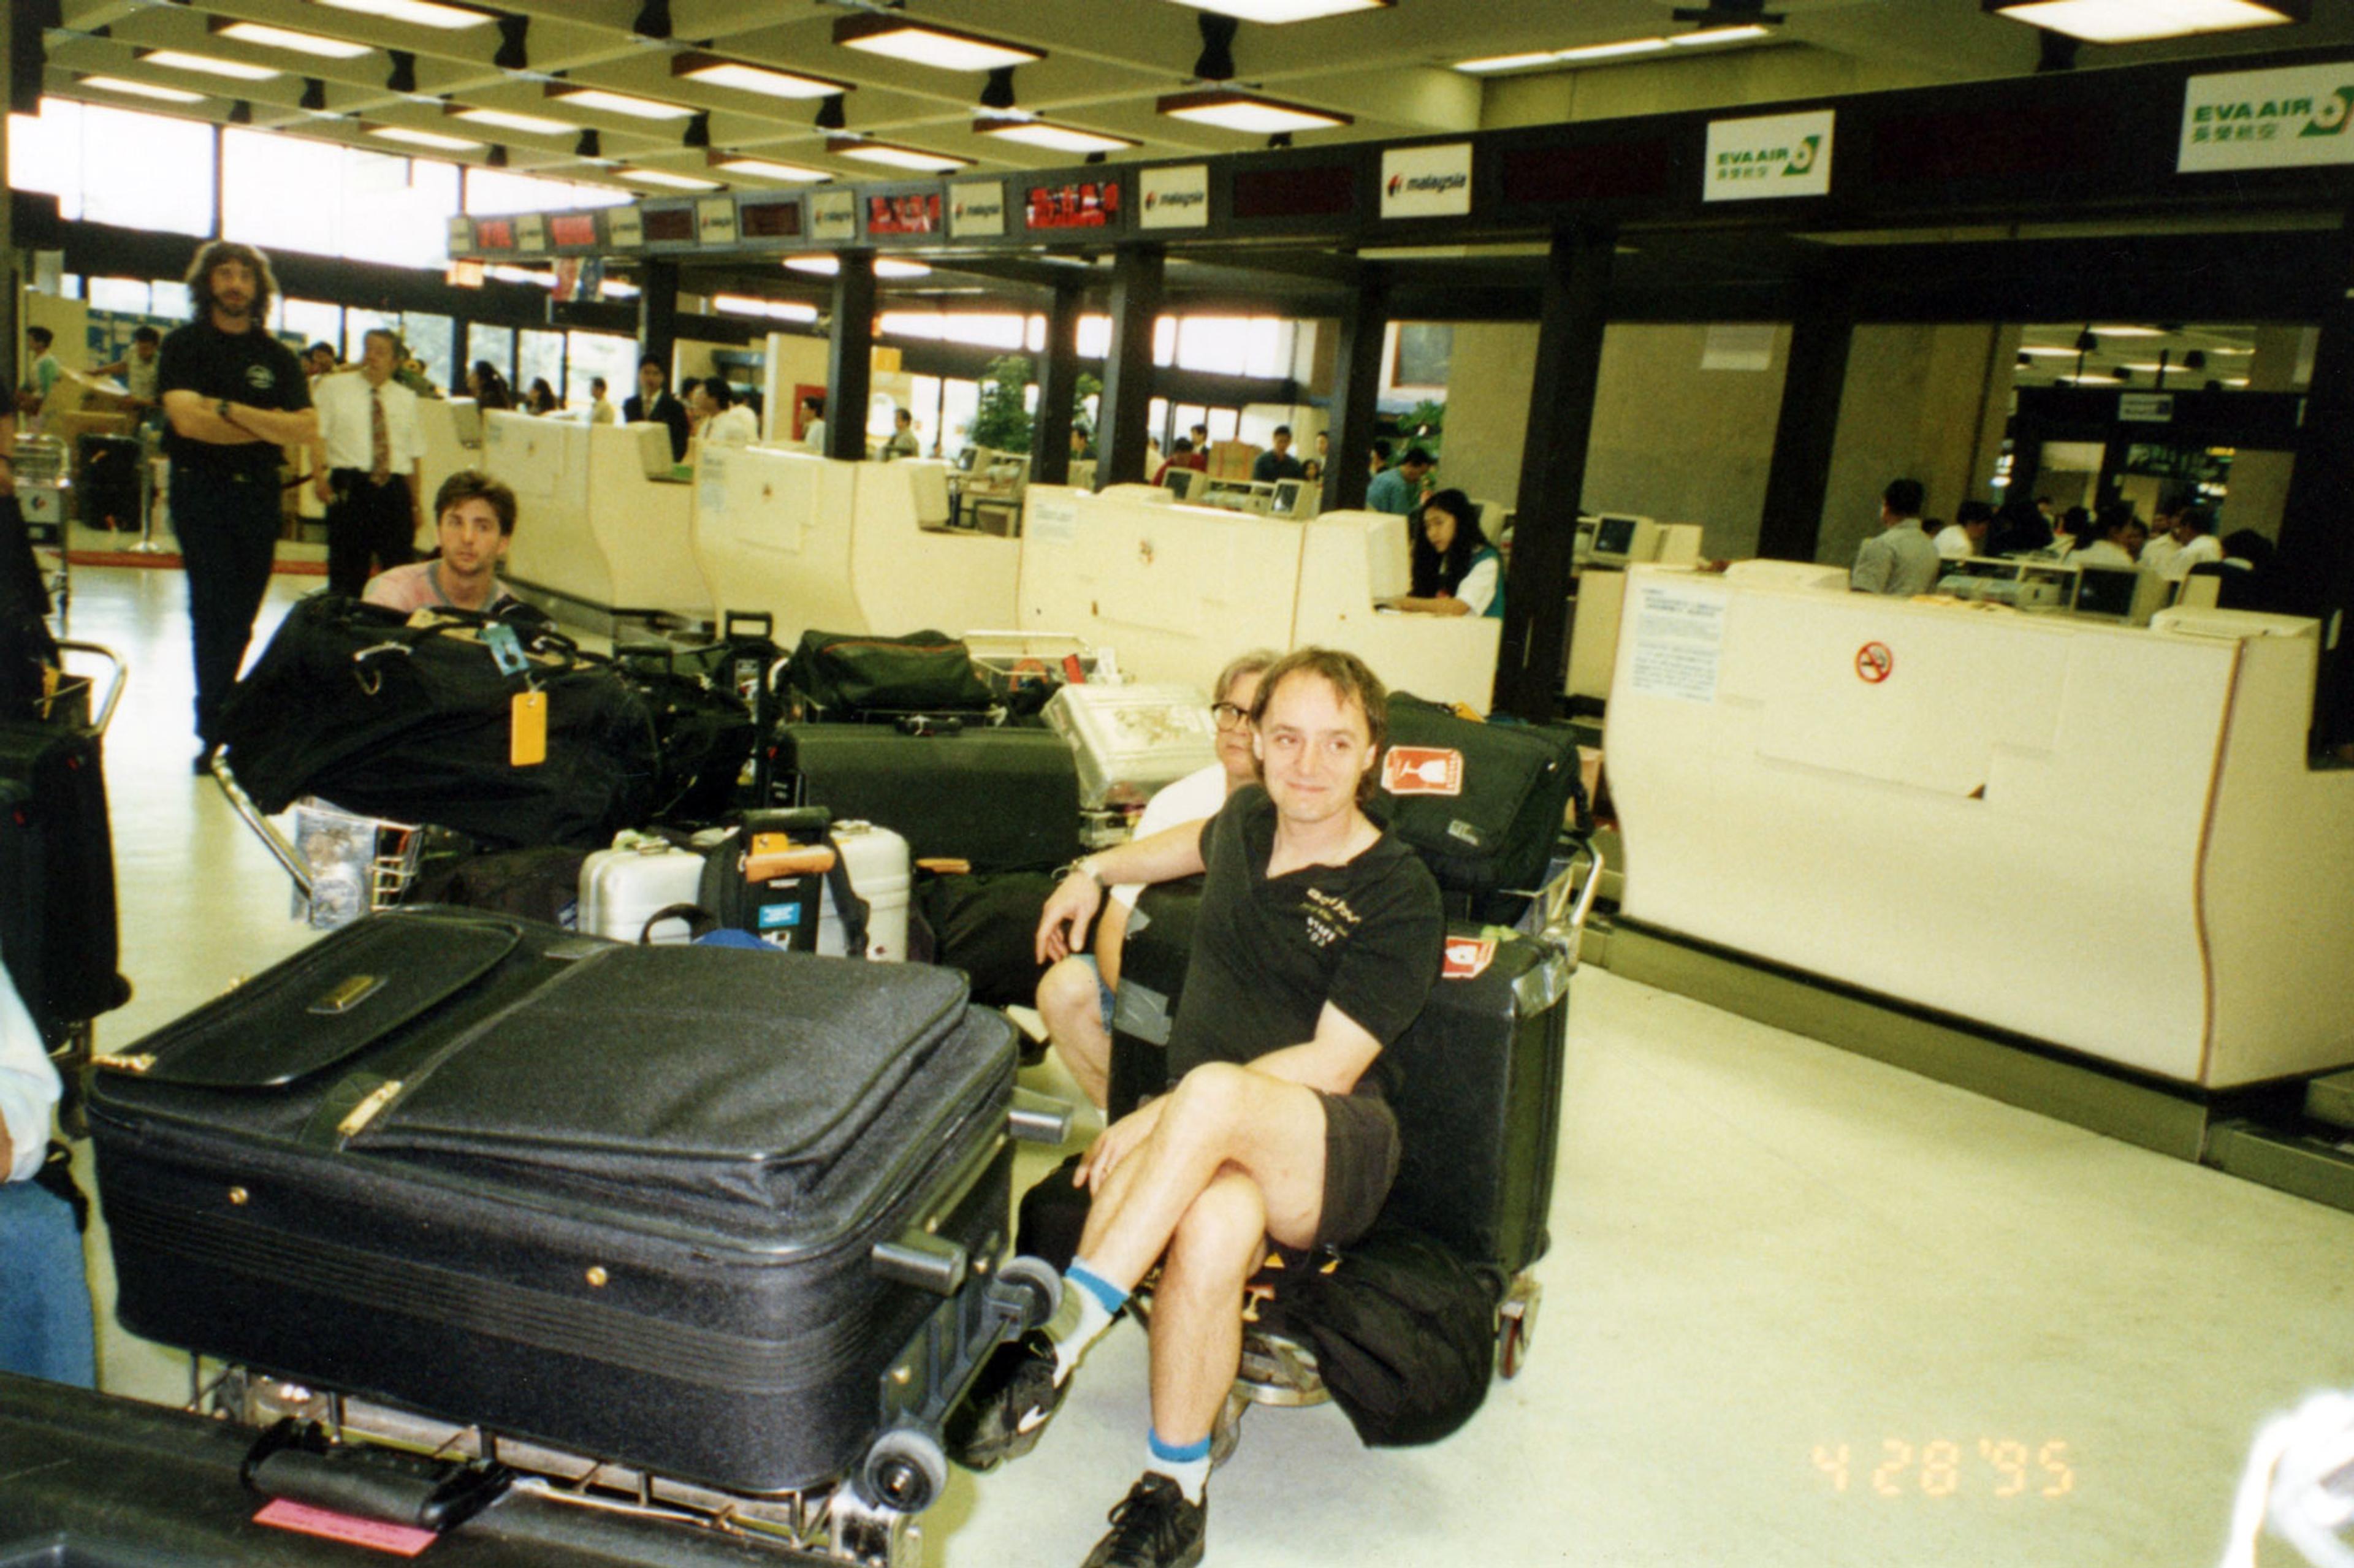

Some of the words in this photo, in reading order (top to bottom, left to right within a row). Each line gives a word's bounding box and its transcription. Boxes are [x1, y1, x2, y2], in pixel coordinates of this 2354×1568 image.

[2193, 102, 2252, 122] EVA
[2257, 97, 2312, 118] AIR
[1718, 151, 1753, 165] EVA
[1757, 148, 1788, 161] AIR
[1407, 173, 1466, 193] malaysia
